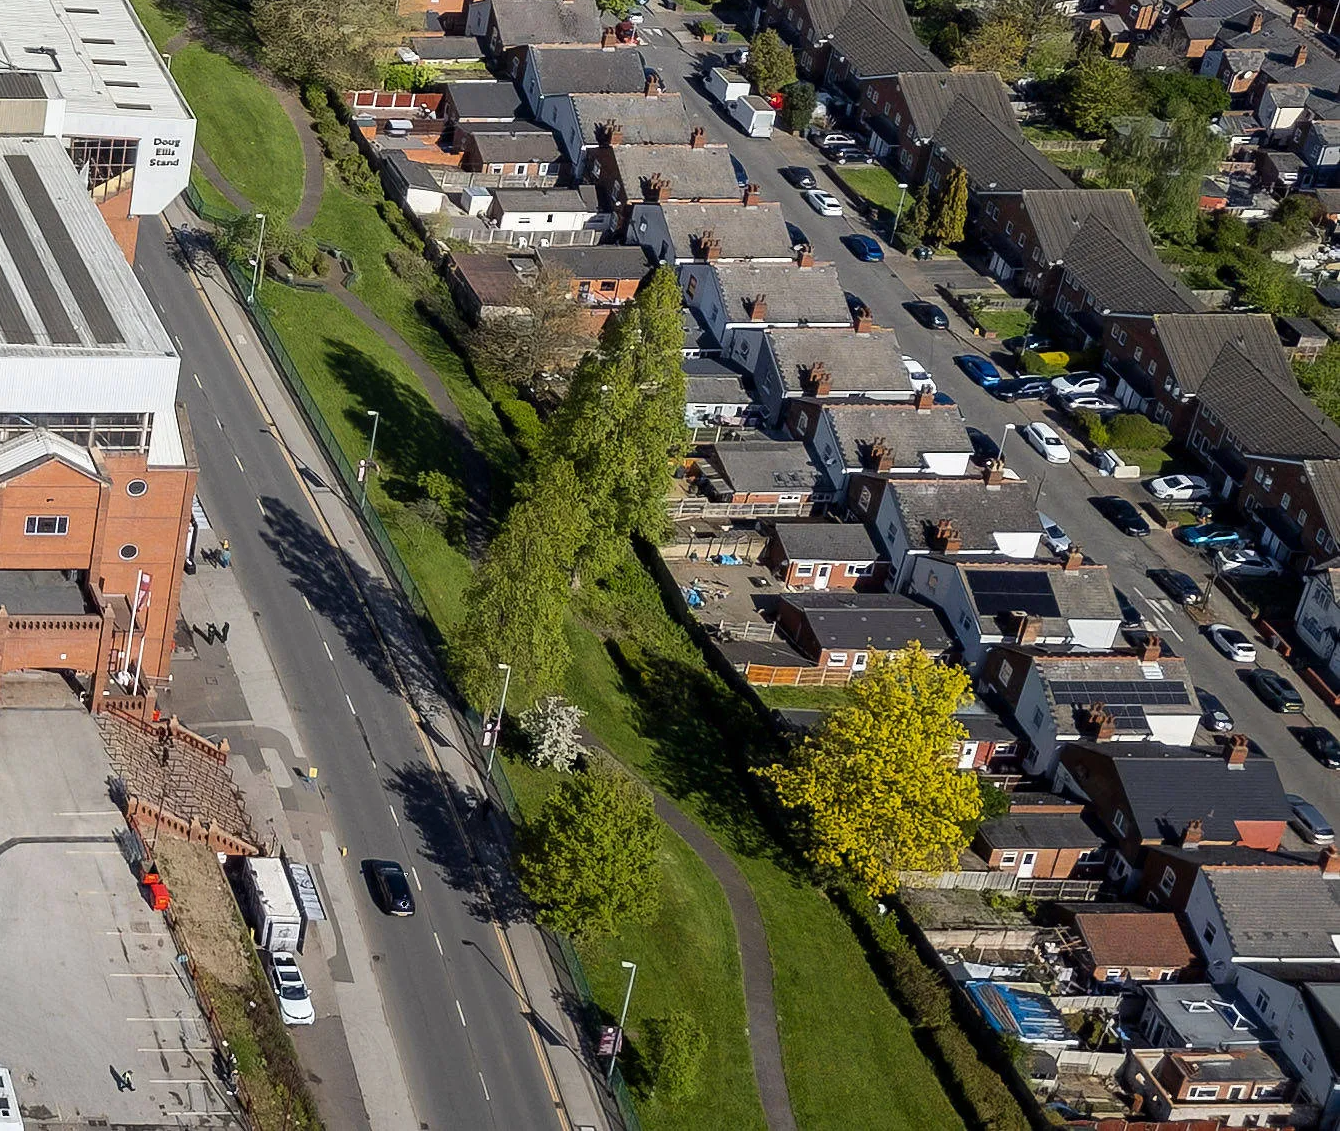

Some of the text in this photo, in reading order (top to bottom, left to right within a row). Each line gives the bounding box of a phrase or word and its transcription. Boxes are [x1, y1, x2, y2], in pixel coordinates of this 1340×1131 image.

[153, 137, 181, 148] Doug
[155, 148, 176, 156] Ellis
[149, 158, 180, 167] Stand
